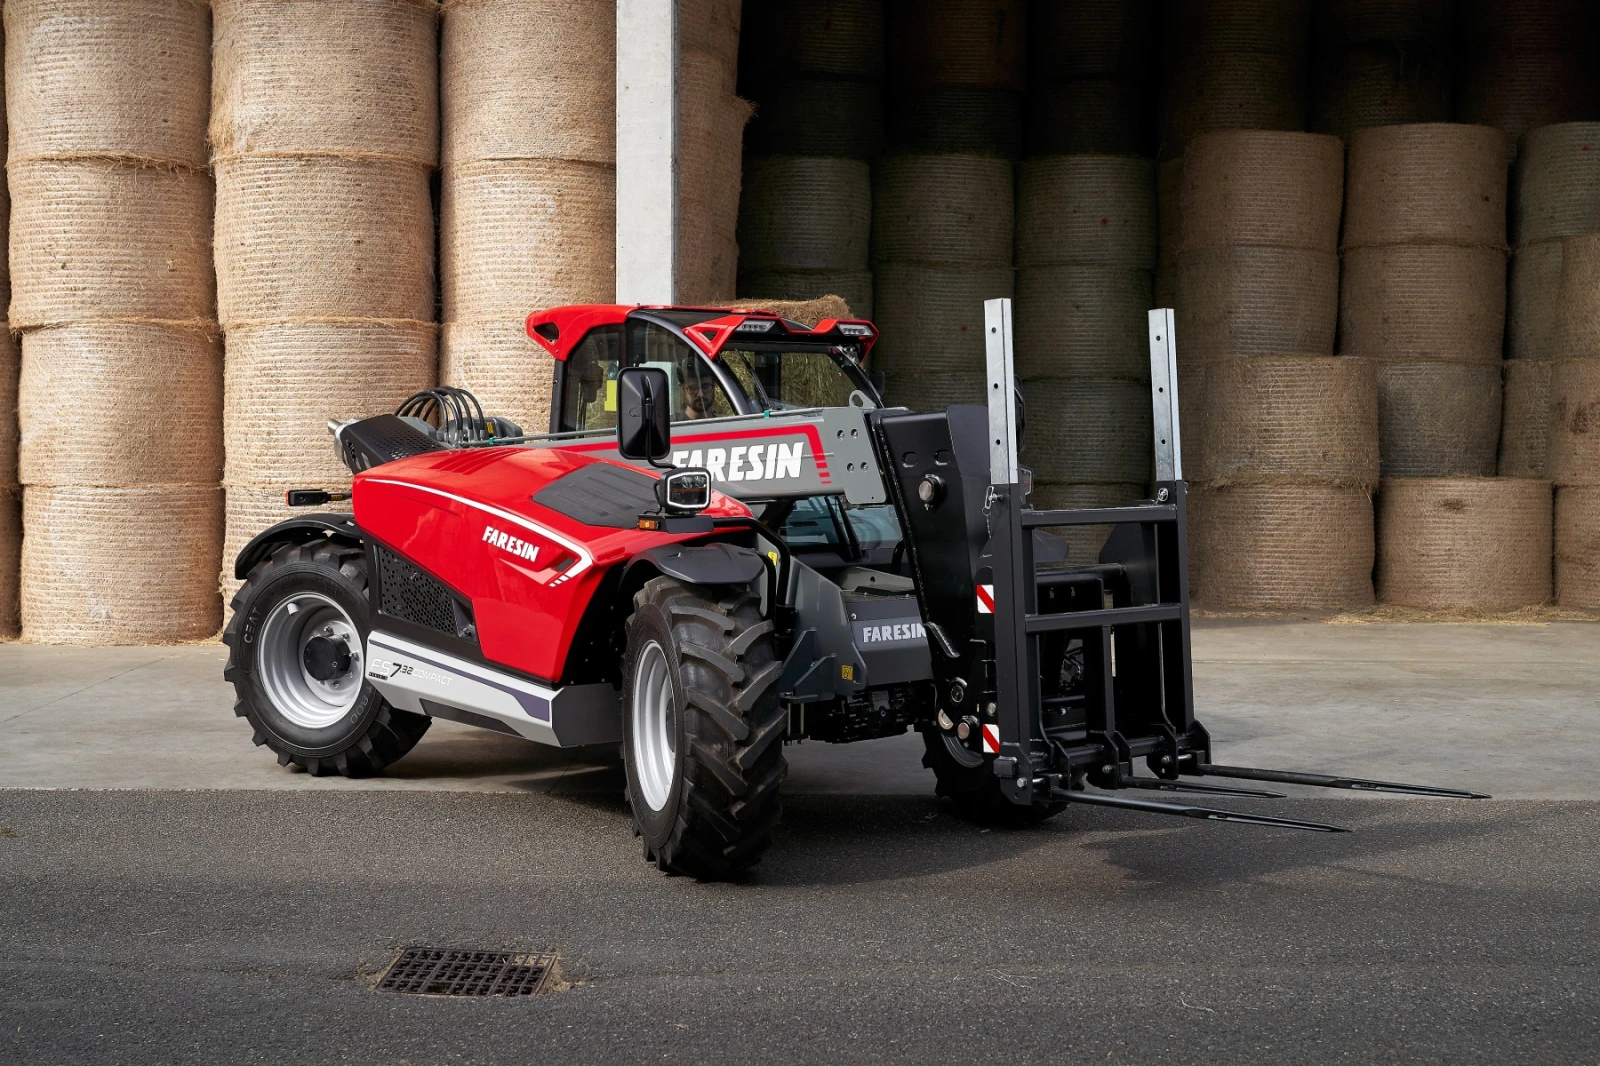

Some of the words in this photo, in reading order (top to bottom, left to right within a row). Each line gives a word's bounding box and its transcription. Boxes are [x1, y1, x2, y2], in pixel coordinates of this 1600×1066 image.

[482, 526, 540, 562] FARESIN
[243, 607, 262, 643] CEAT
[863, 623, 927, 643] FARESIN
